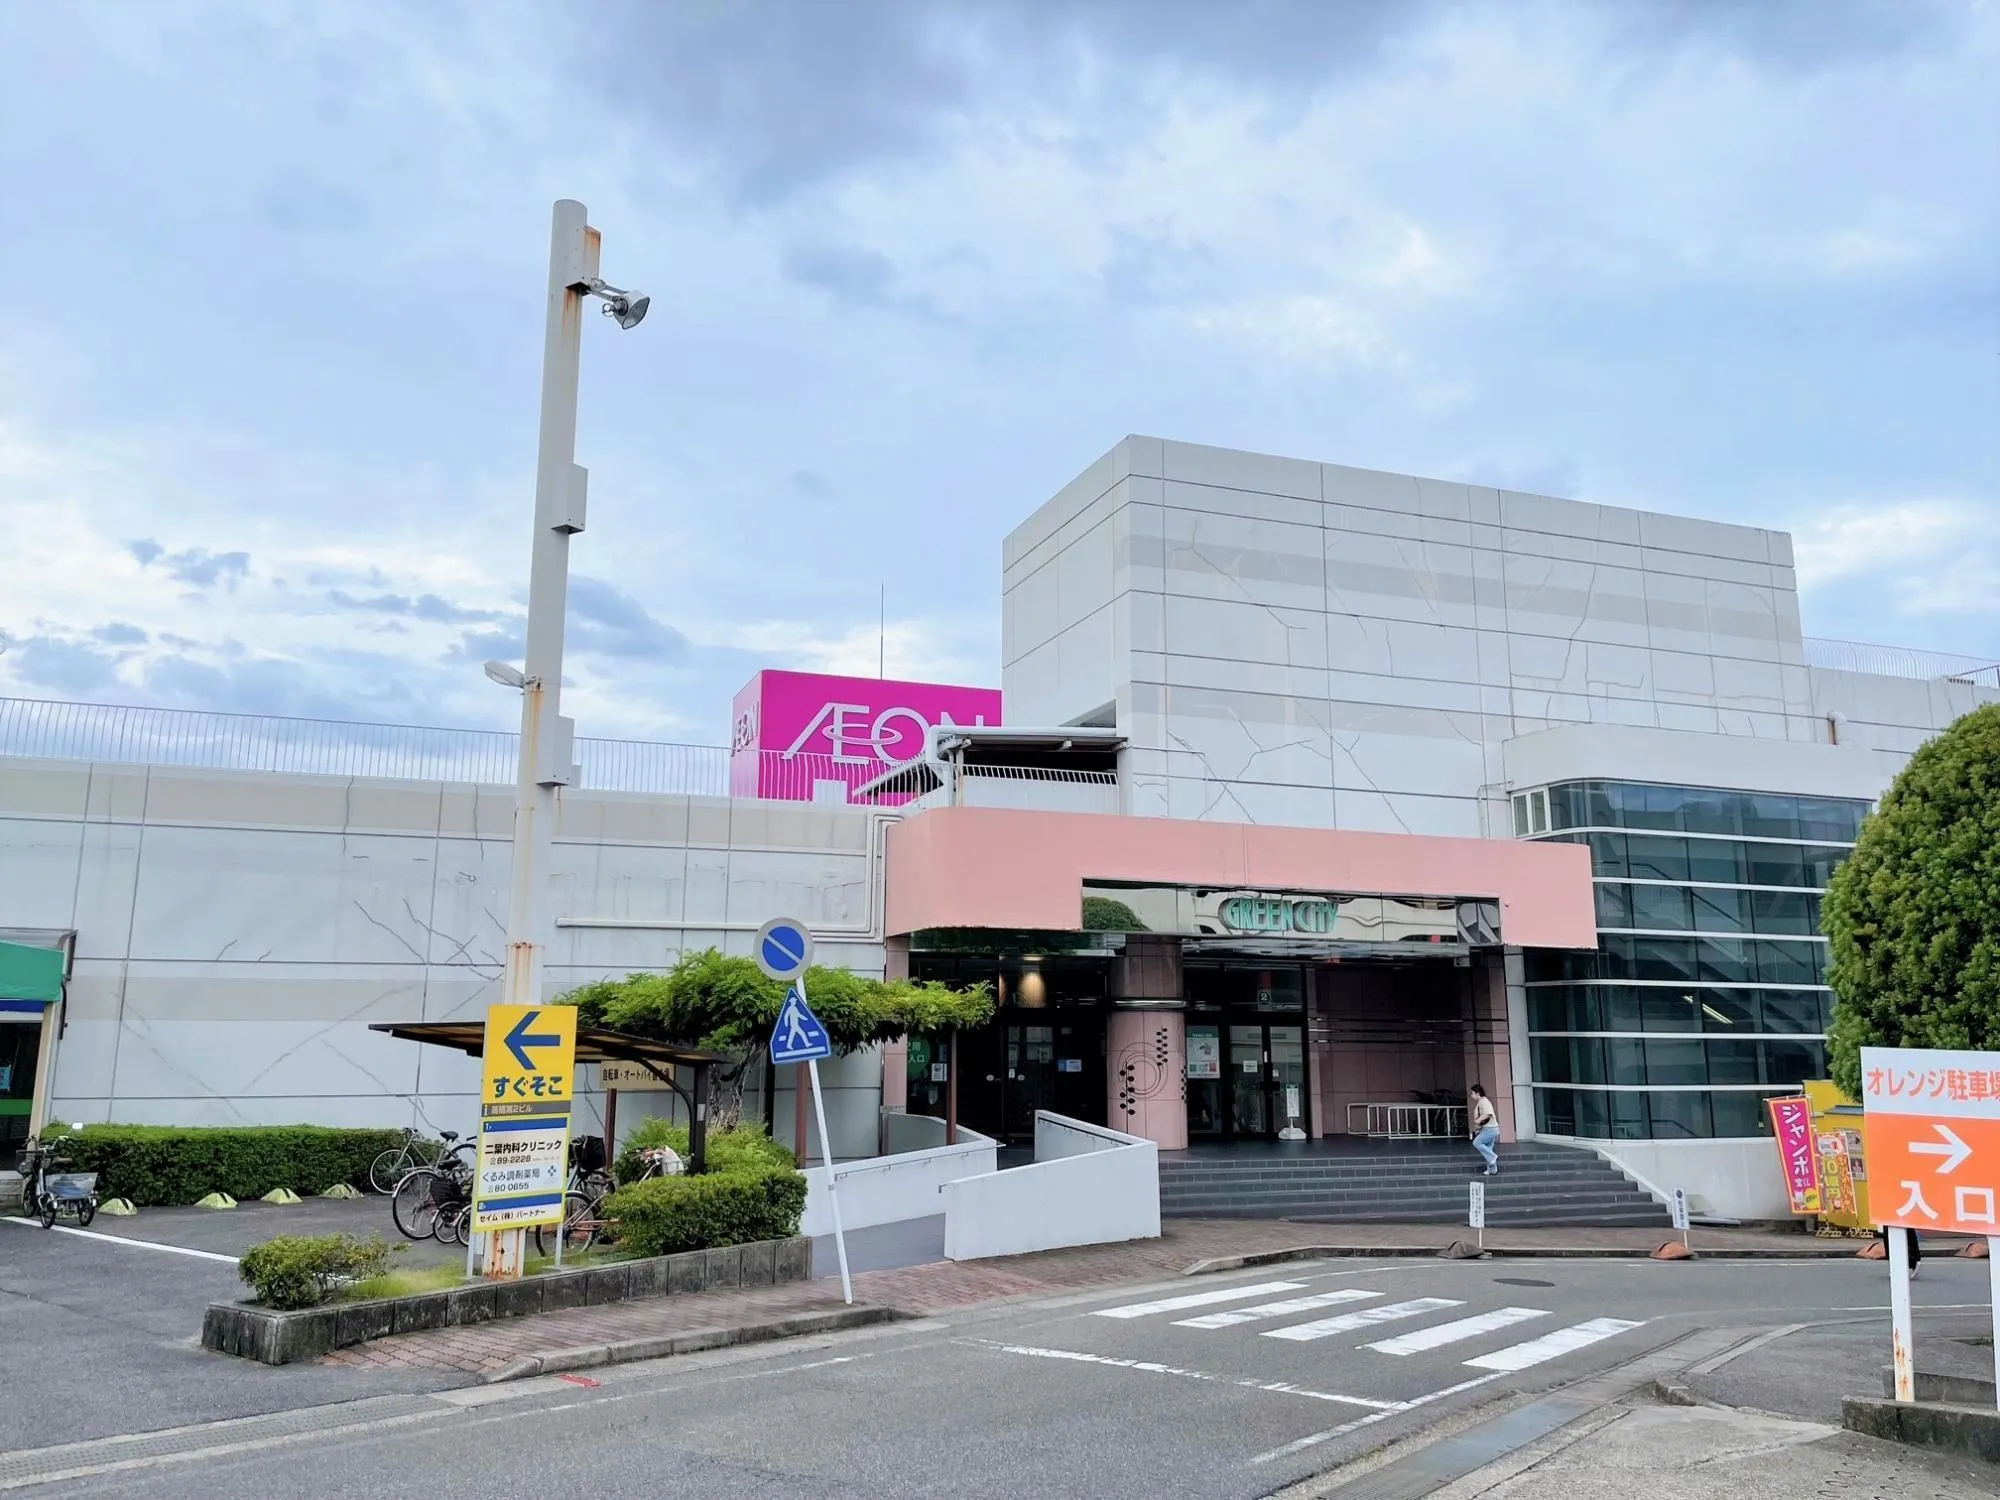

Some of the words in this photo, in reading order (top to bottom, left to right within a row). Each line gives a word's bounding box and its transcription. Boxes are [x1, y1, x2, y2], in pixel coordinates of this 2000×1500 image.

[1219, 898, 1294, 931] GREEN
[493, 1076, 563, 1099] すぐそこ
[485, 1140, 562, 1155] 二葉内科クリニック
[482, 1168, 541, 1183] くるみ調剤薬局
[1896, 1180, 1996, 1224] 入口
